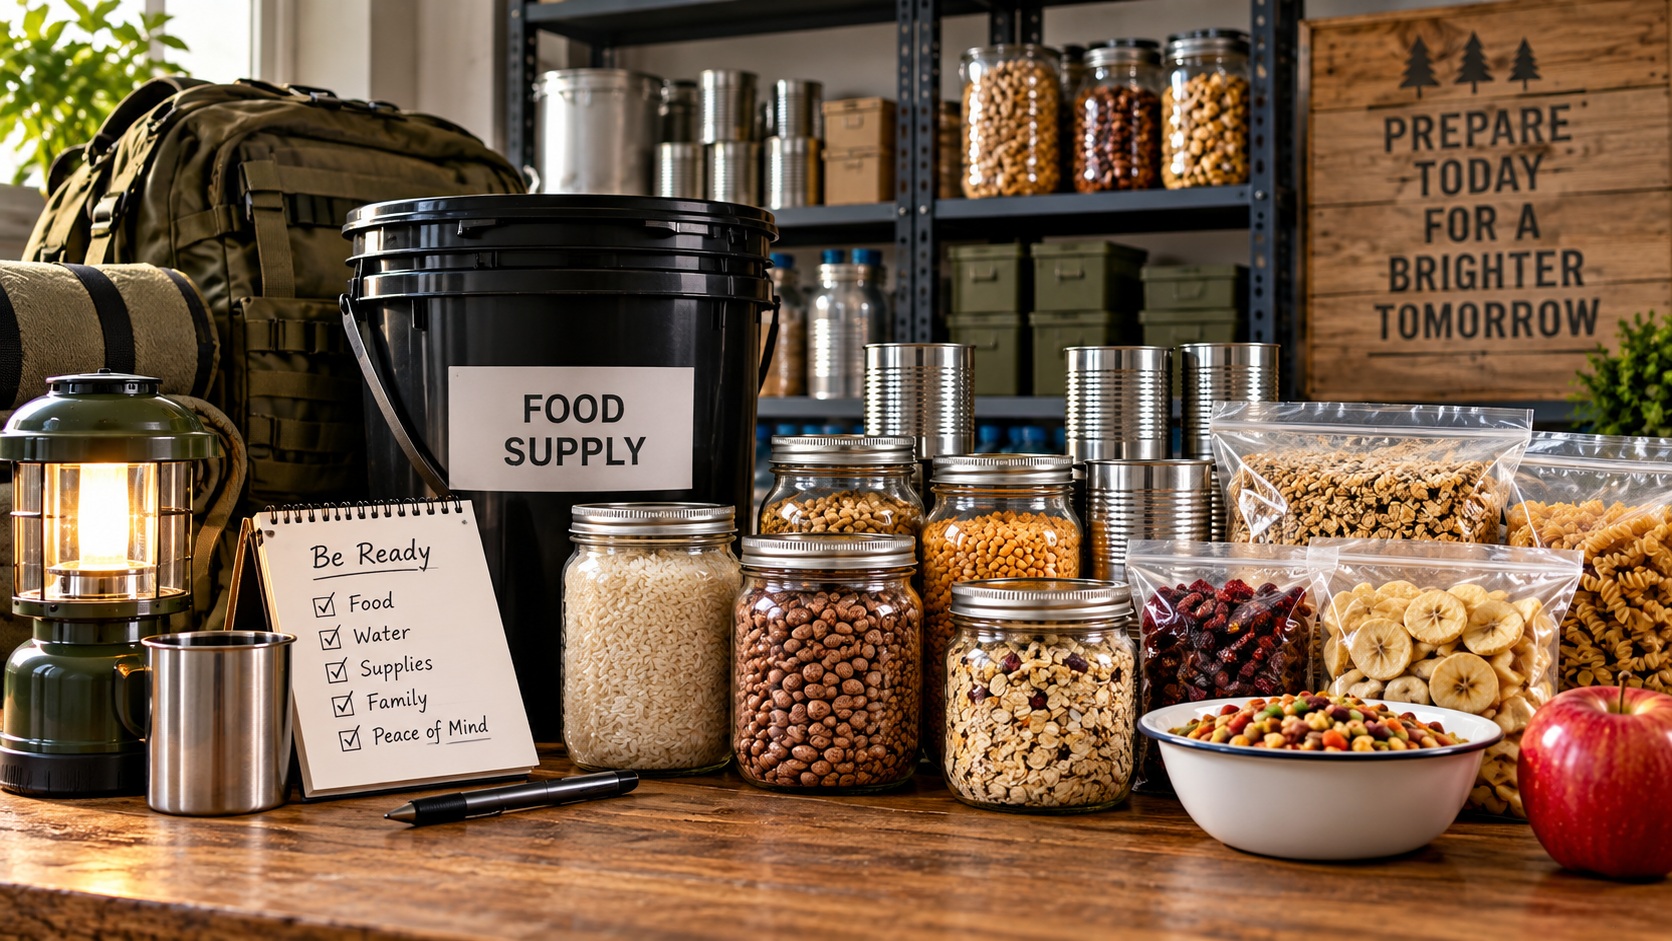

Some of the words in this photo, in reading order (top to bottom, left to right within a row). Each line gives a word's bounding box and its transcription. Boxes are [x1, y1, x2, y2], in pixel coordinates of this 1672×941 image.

[1384, 104, 1572, 153] PREPARE
[1414, 153, 1544, 196] TODAY
[1424, 205, 1497, 243] FOR
[1515, 203, 1540, 240] A
[1388, 249, 1584, 293] BRIGHTER
[1374, 298, 1600, 340] TOMORROW
[524, 394, 624, 423] FOOD
[504, 437, 646, 466] SUPPLY
[310, 544, 344, 568] Be
[356, 538, 431, 572] Ready
[349, 591, 394, 612] Food
[353, 626, 410, 644] Water
[360, 655, 433, 681] Supplies
[367, 688, 427, 713] Family
[372, 726, 420, 745] Peace
[426, 720, 442, 744] of
[448, 715, 488, 736] Mind
